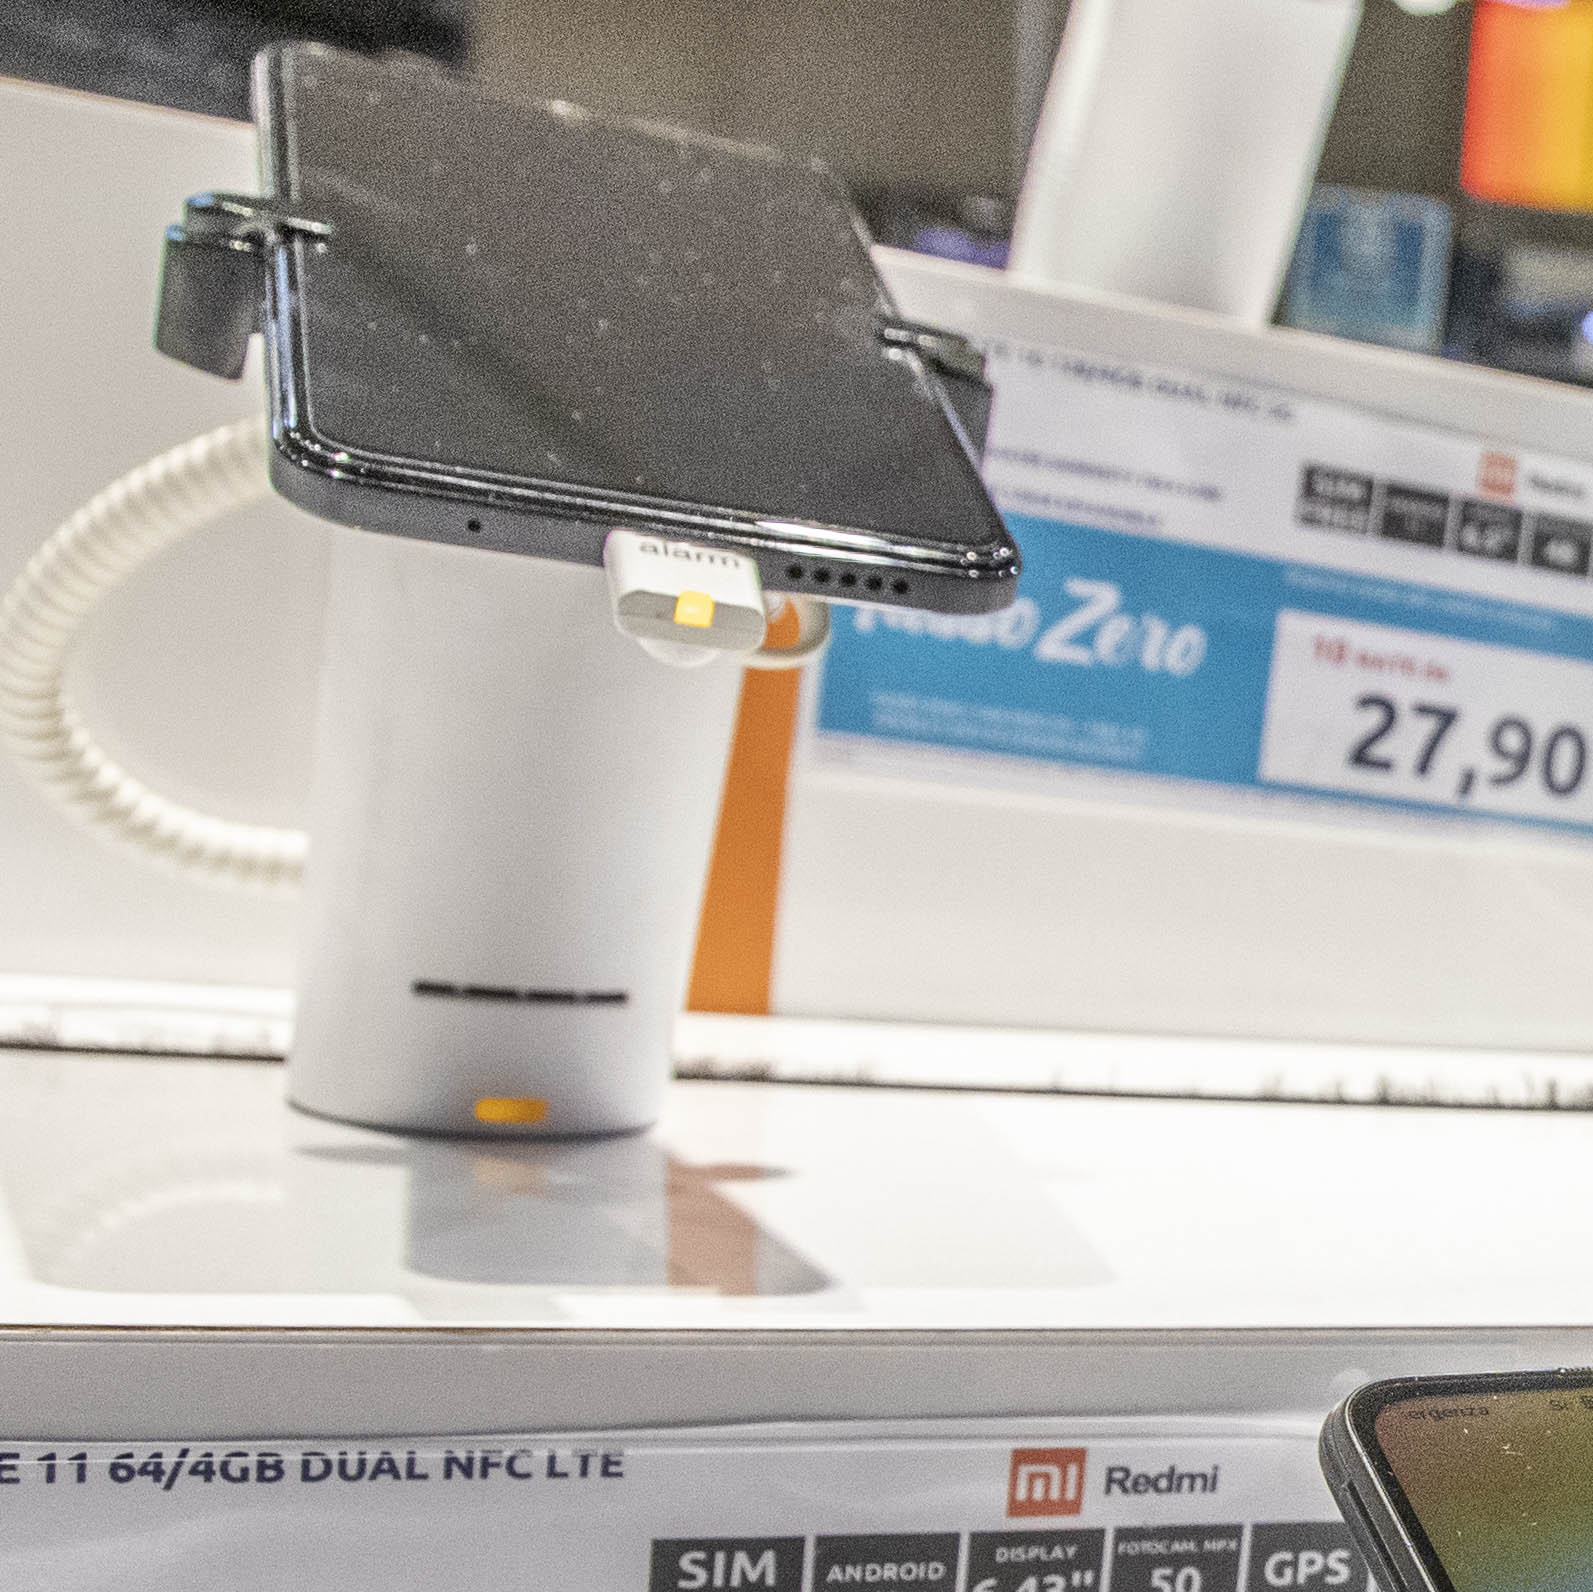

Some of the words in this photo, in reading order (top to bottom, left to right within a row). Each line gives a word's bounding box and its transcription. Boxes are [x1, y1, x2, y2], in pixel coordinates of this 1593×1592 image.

[1033, 577, 1208, 677] Zero
[1348, 692, 1587, 805] 27,90
[37, 1451, 87, 1484] 11
[108, 1448, 285, 1491] 64/4GB
[300, 1450, 430, 1484] DUAL
[442, 1449, 533, 1482] NFC
[545, 1450, 627, 1481] LTE
[1104, 1464, 1220, 1497] Redmi
[676, 1550, 777, 1590] SIM
[826, 1560, 946, 1583] ANDROID
[994, 1544, 1078, 1564] DISPLAY
[1263, 1549, 1352, 1588] GPS
